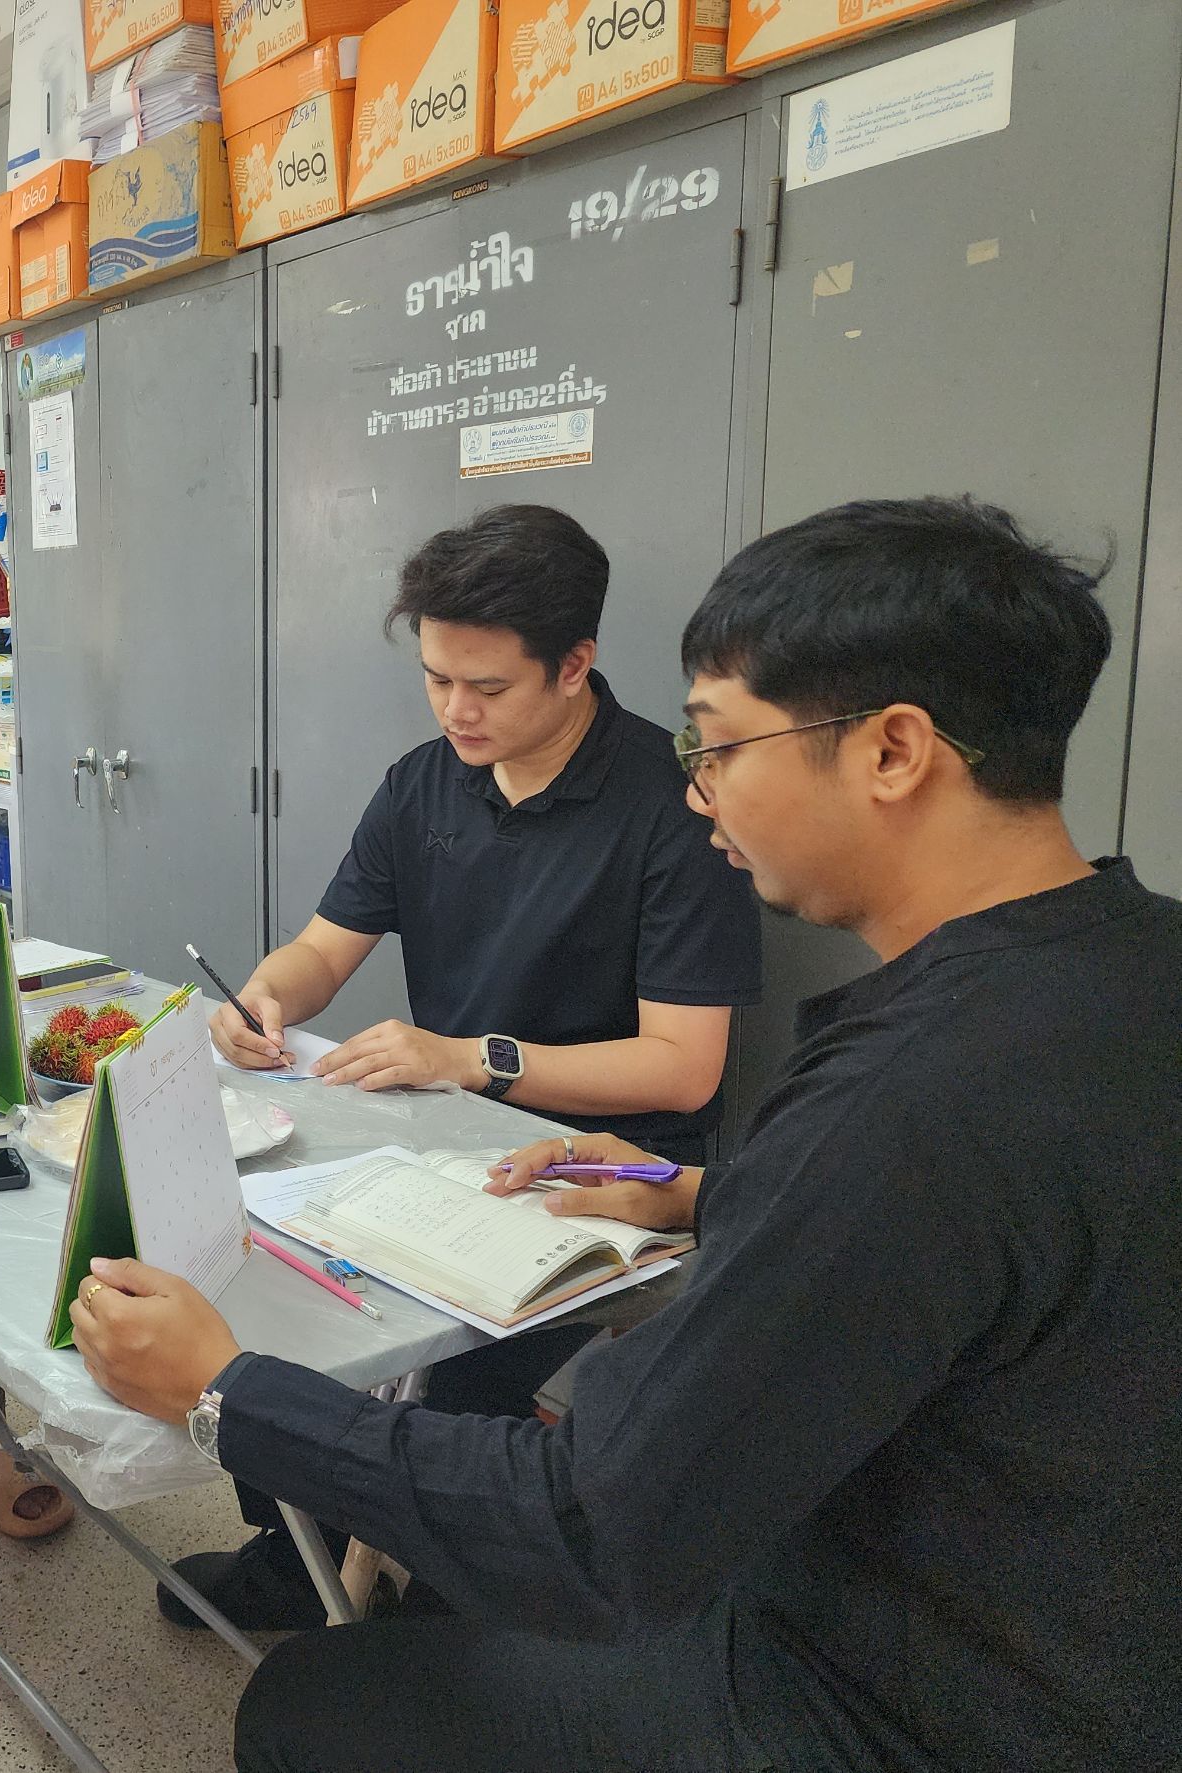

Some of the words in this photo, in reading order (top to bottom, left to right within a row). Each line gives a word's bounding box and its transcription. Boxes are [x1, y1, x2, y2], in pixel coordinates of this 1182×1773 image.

[587, 0, 665, 56] idea
[452, 69, 467, 80] MAX
[598, 76, 618, 102] A4
[624, 56, 669, 90] 5x500
[410, 84, 467, 132] idea
[277, 151, 327, 190] idea
[418, 150, 432, 171] A4
[436, 135, 470, 162] 5x500
[292, 208, 305, 222] A4
[306, 197, 334, 218] 5x500
[452, 181, 488, 199] KINGKONG
[568, 164, 720, 242] 19/29
[406, 231, 534, 317] ธารน้ำใจ
[445, 309, 486, 341] จาก
